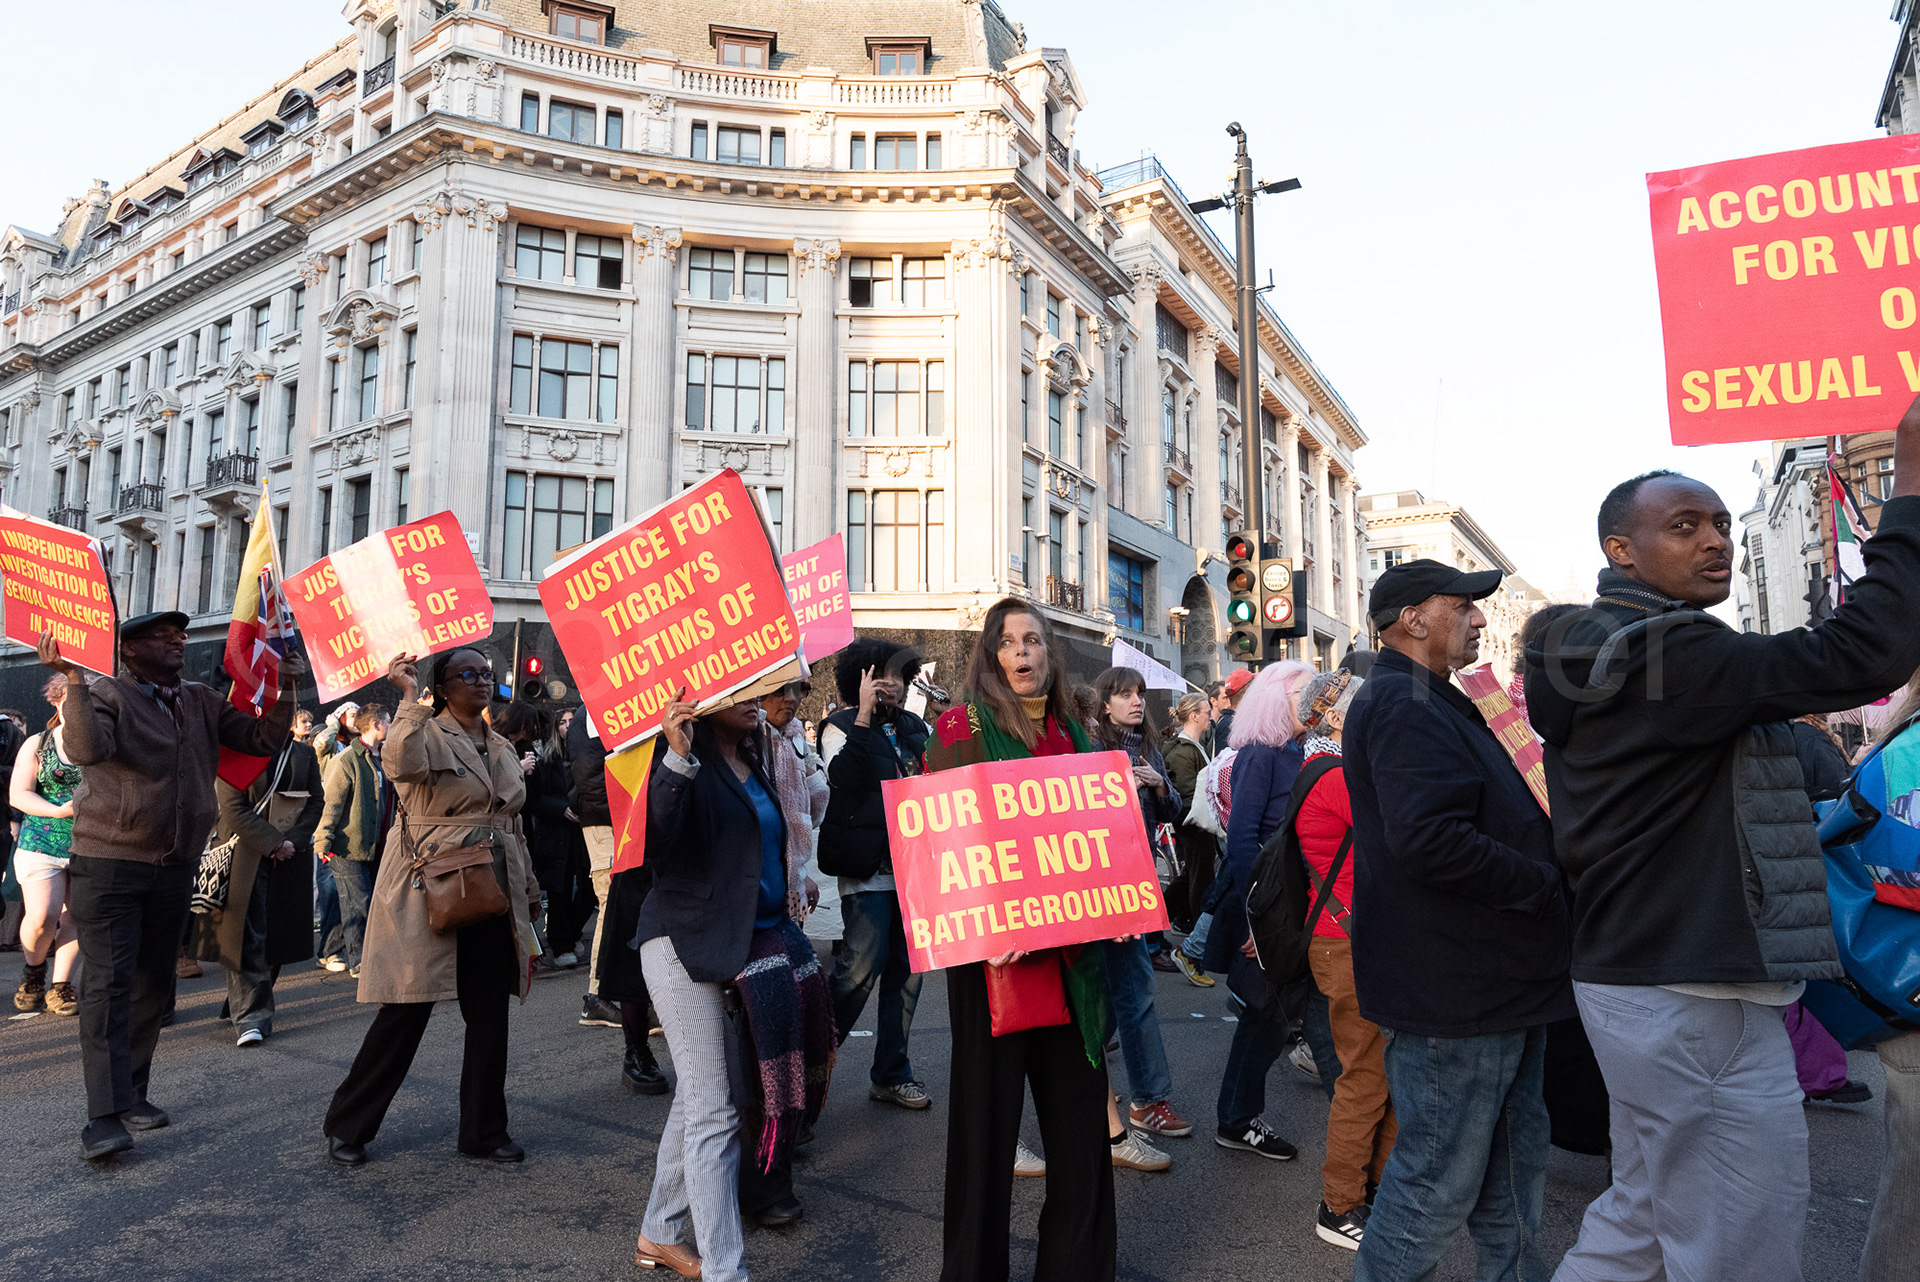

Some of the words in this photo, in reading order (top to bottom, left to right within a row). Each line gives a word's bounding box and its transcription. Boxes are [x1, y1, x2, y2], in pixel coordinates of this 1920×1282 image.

[1677, 165, 1920, 235] ACCOUNT
[1733, 235, 1839, 285] FOR
[1853, 223, 1920, 270] VI
[1880, 286, 1917, 330] O
[1681, 355, 1882, 413] SEXUAL
[1, 529, 90, 571] INDEPENDENT
[391, 524, 446, 558] FOR
[565, 526, 670, 611] JUSTICE
[670, 491, 732, 546] FOR
[0, 553, 88, 598] INVESTIGATION
[92, 580, 108, 602] OF
[6, 577, 48, 610] SEXUAL
[47, 594, 110, 632] VIOLENCE
[330, 563, 431, 621] TIGRAY'S
[600, 551, 721, 638] TIGRAY'S
[818, 569, 842, 593] OF
[30, 613, 42, 634] IN
[45, 618, 87, 650] TIGRAY
[326, 654, 390, 692] SEXUAL
[394, 612, 490, 653] VIOLENCE
[328, 600, 421, 660] VICTIMS
[426, 588, 459, 616] OF
[600, 608, 716, 690] VICTIMS
[719, 582, 756, 627] OF
[603, 685, 678, 736] SEXUAL
[683, 614, 793, 692] VIOLENCE
[897, 787, 982, 838] OUR
[992, 771, 1128, 821] BODIES
[940, 840, 1024, 894] ARE
[1033, 829, 1112, 876] NOT
[911, 880, 1158, 950] BATTLEGROUNDS
